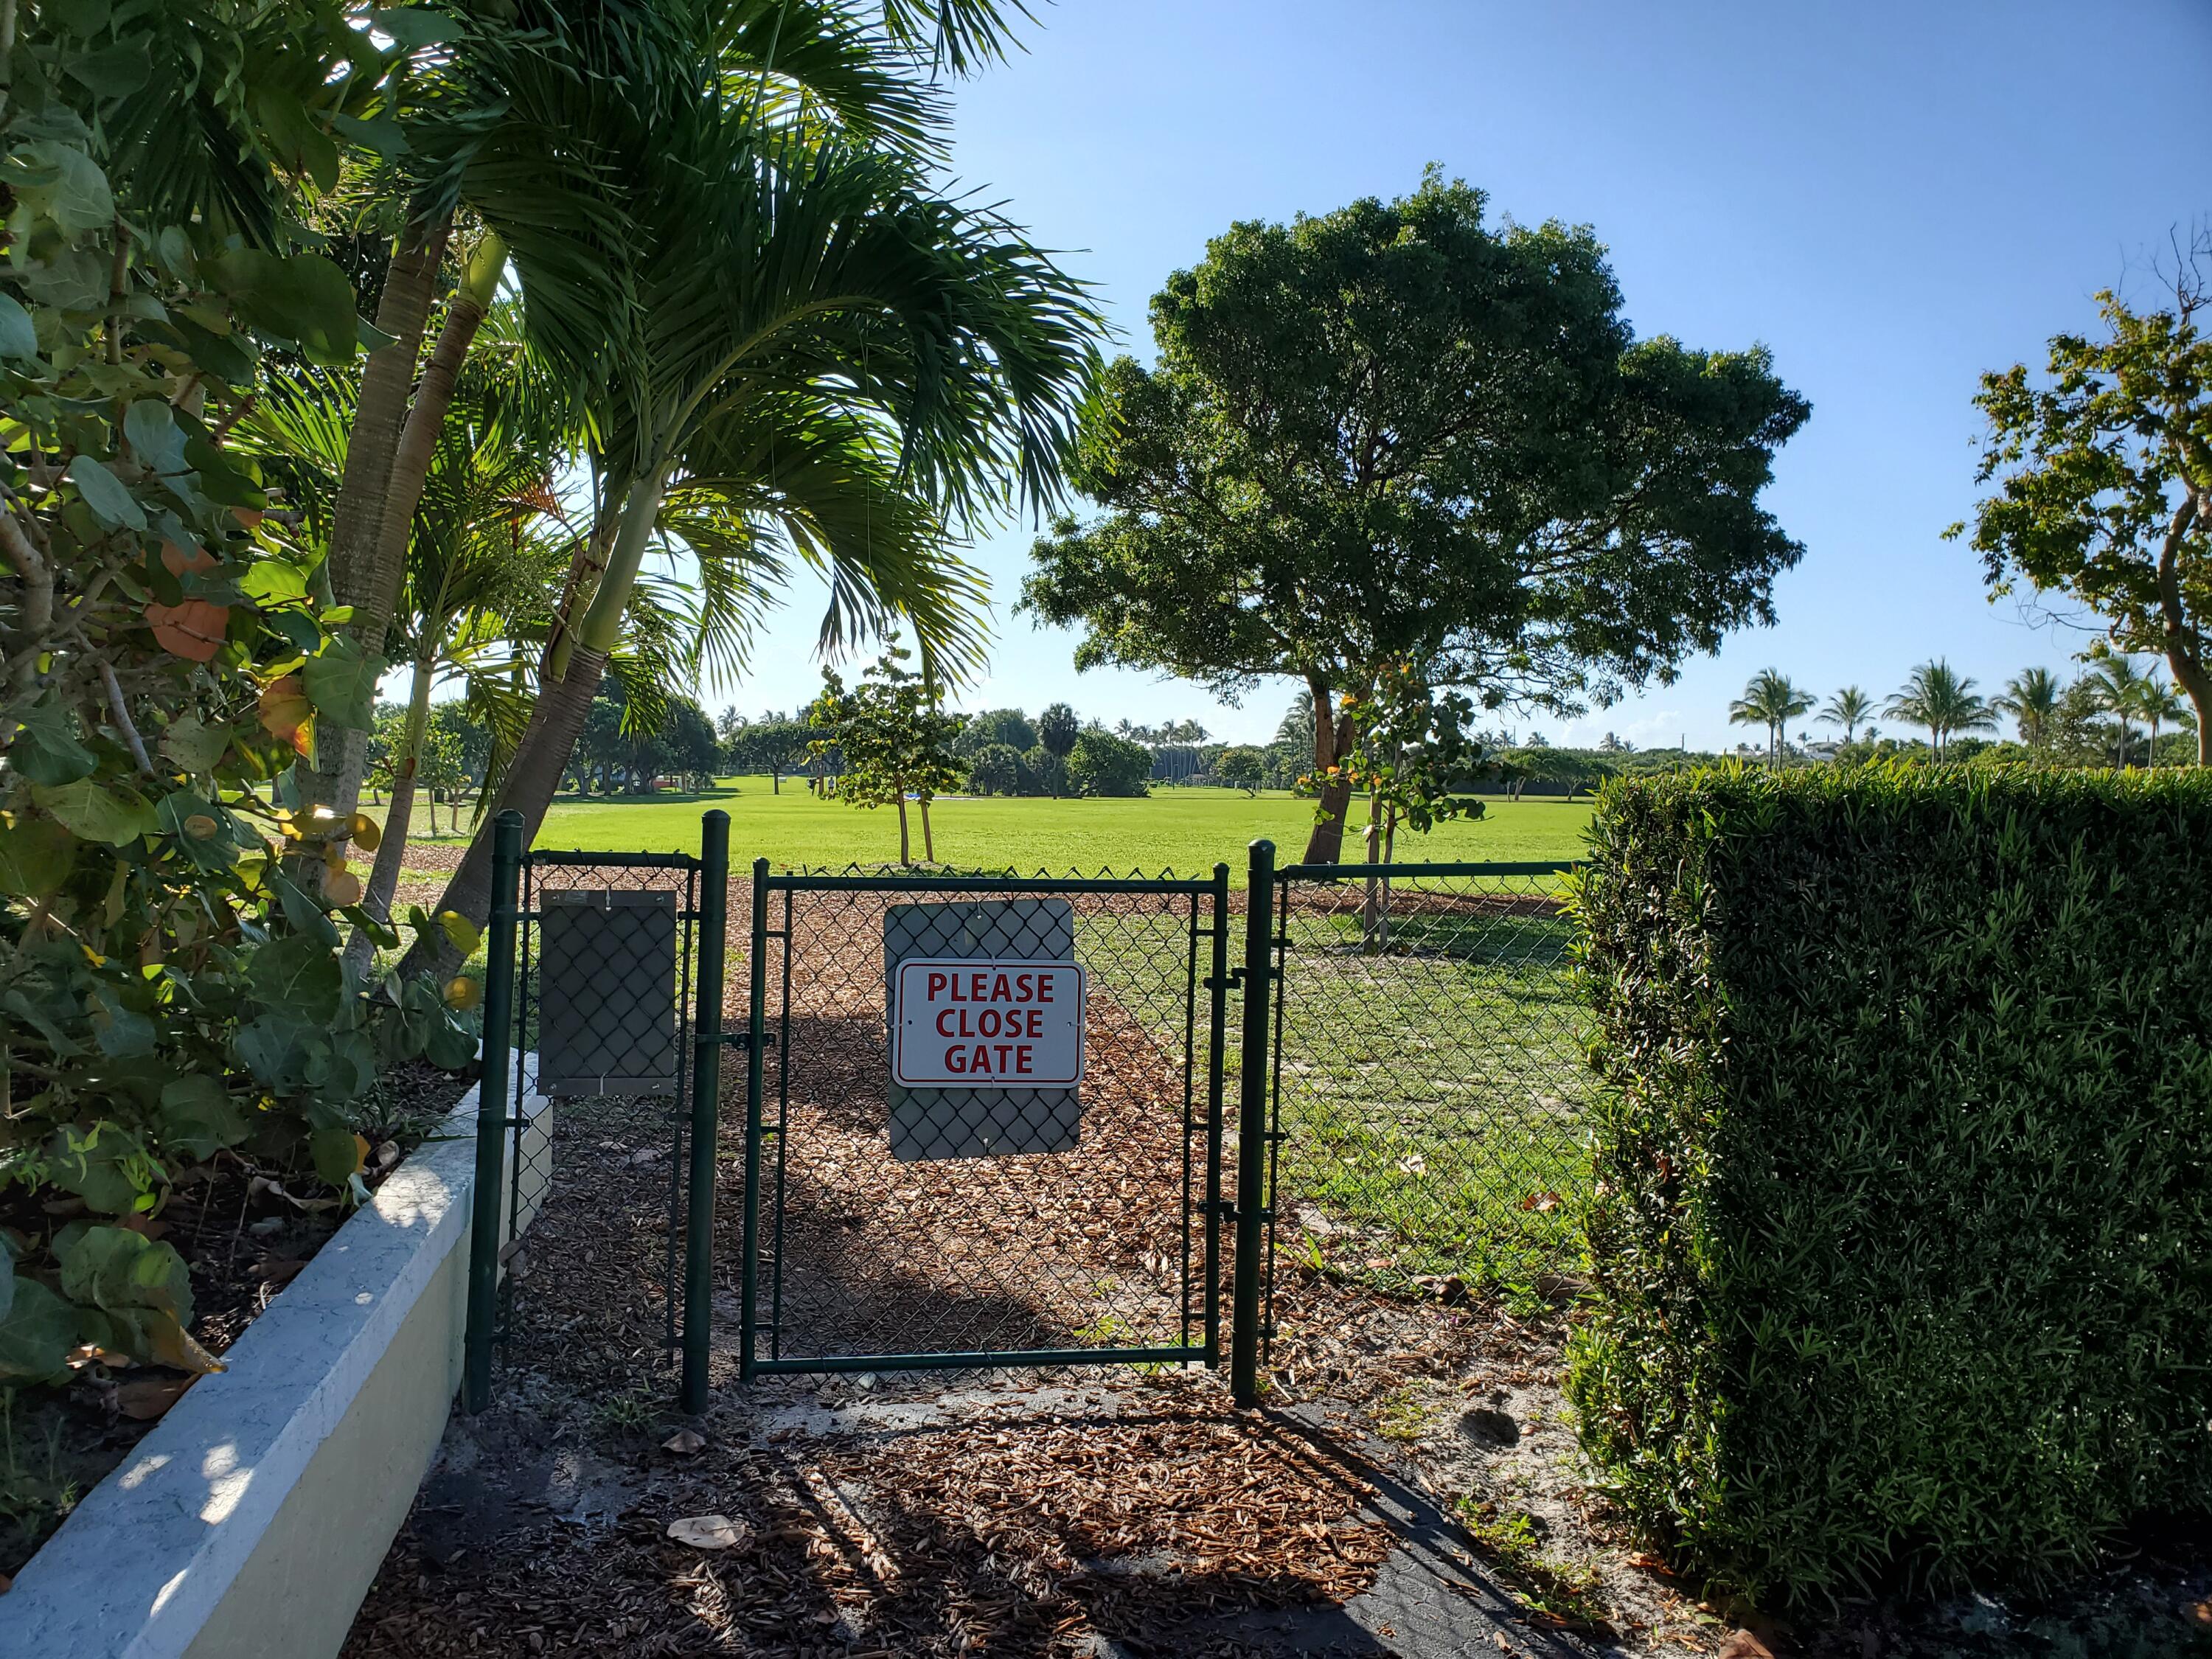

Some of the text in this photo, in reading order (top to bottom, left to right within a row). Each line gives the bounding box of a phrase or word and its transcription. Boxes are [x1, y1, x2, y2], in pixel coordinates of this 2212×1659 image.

[928, 973, 1054, 1003] PLEASE
[936, 1009, 1043, 1038] CLOSE
[945, 1045, 1033, 1074] GATE
